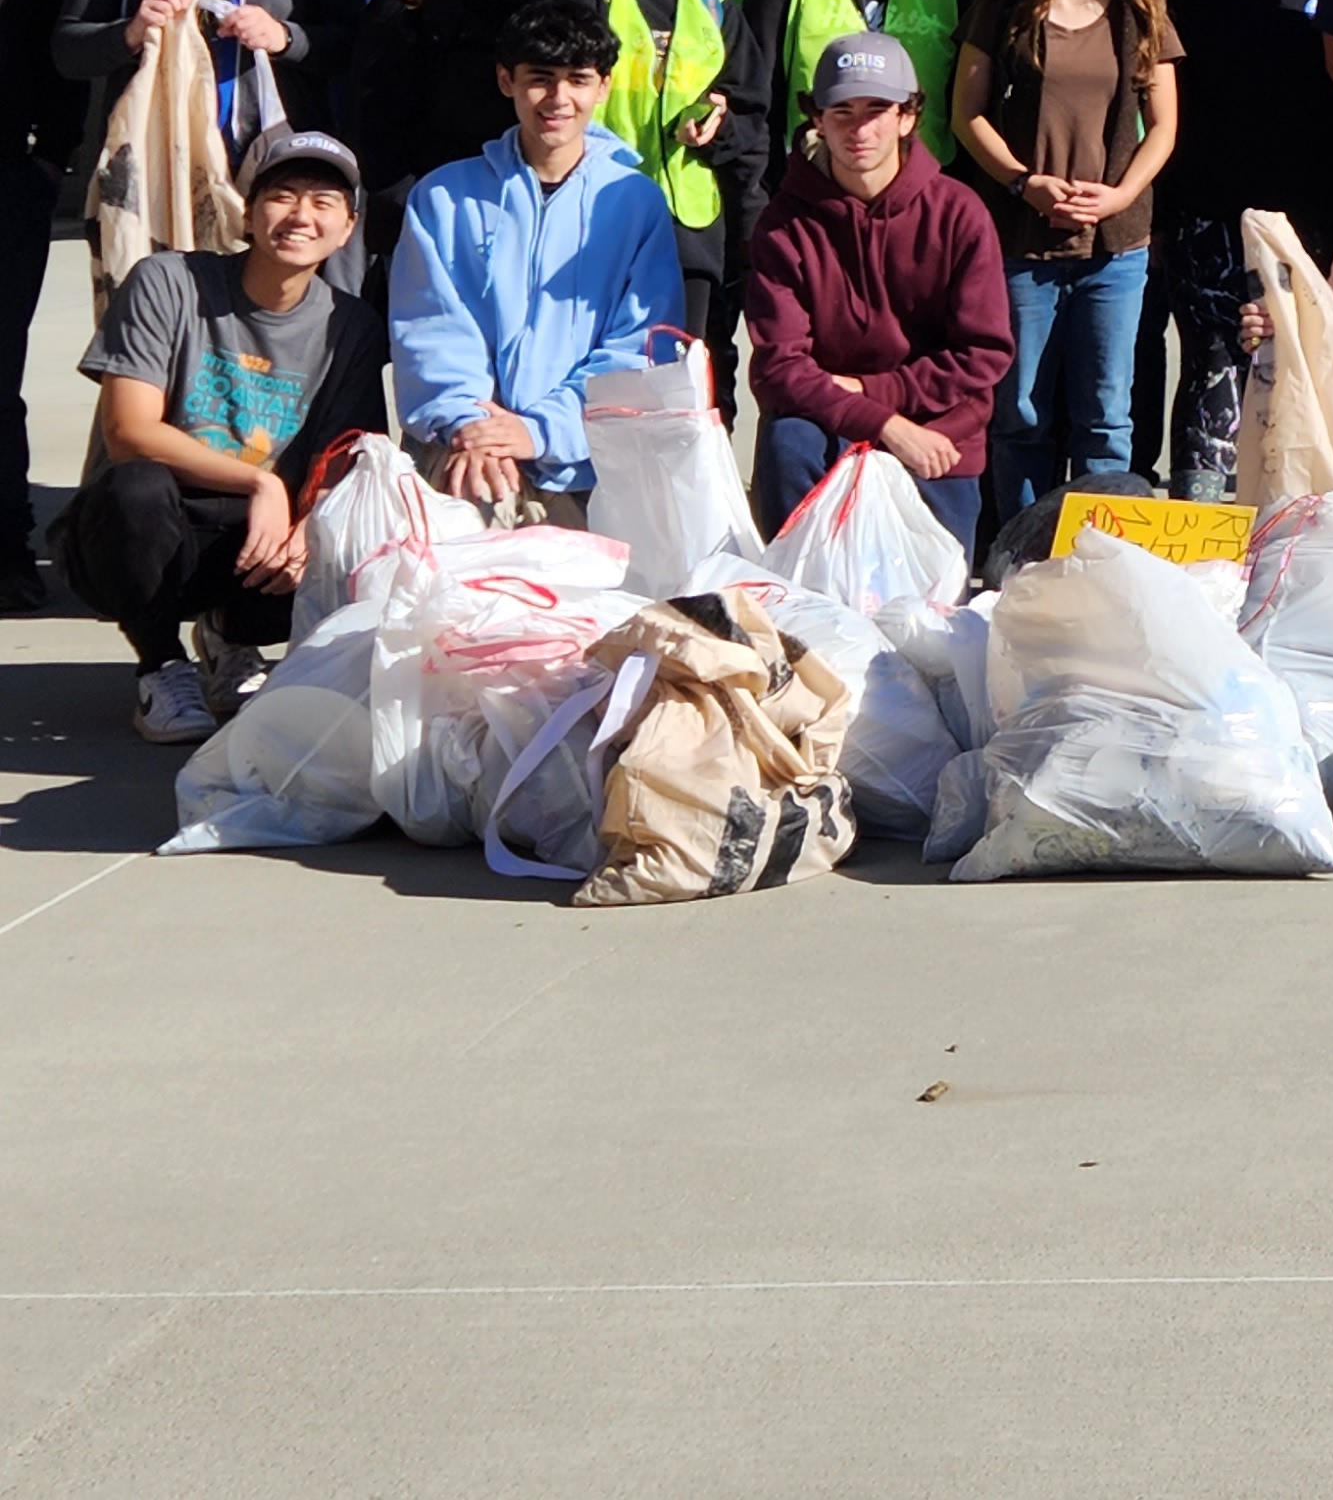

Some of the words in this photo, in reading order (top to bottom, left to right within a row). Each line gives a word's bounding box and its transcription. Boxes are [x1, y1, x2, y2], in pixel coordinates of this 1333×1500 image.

[836, 51, 886, 70] ORIS
[184, 389, 300, 442] CLEANUP
[194, 368, 301, 421] COASTAL
